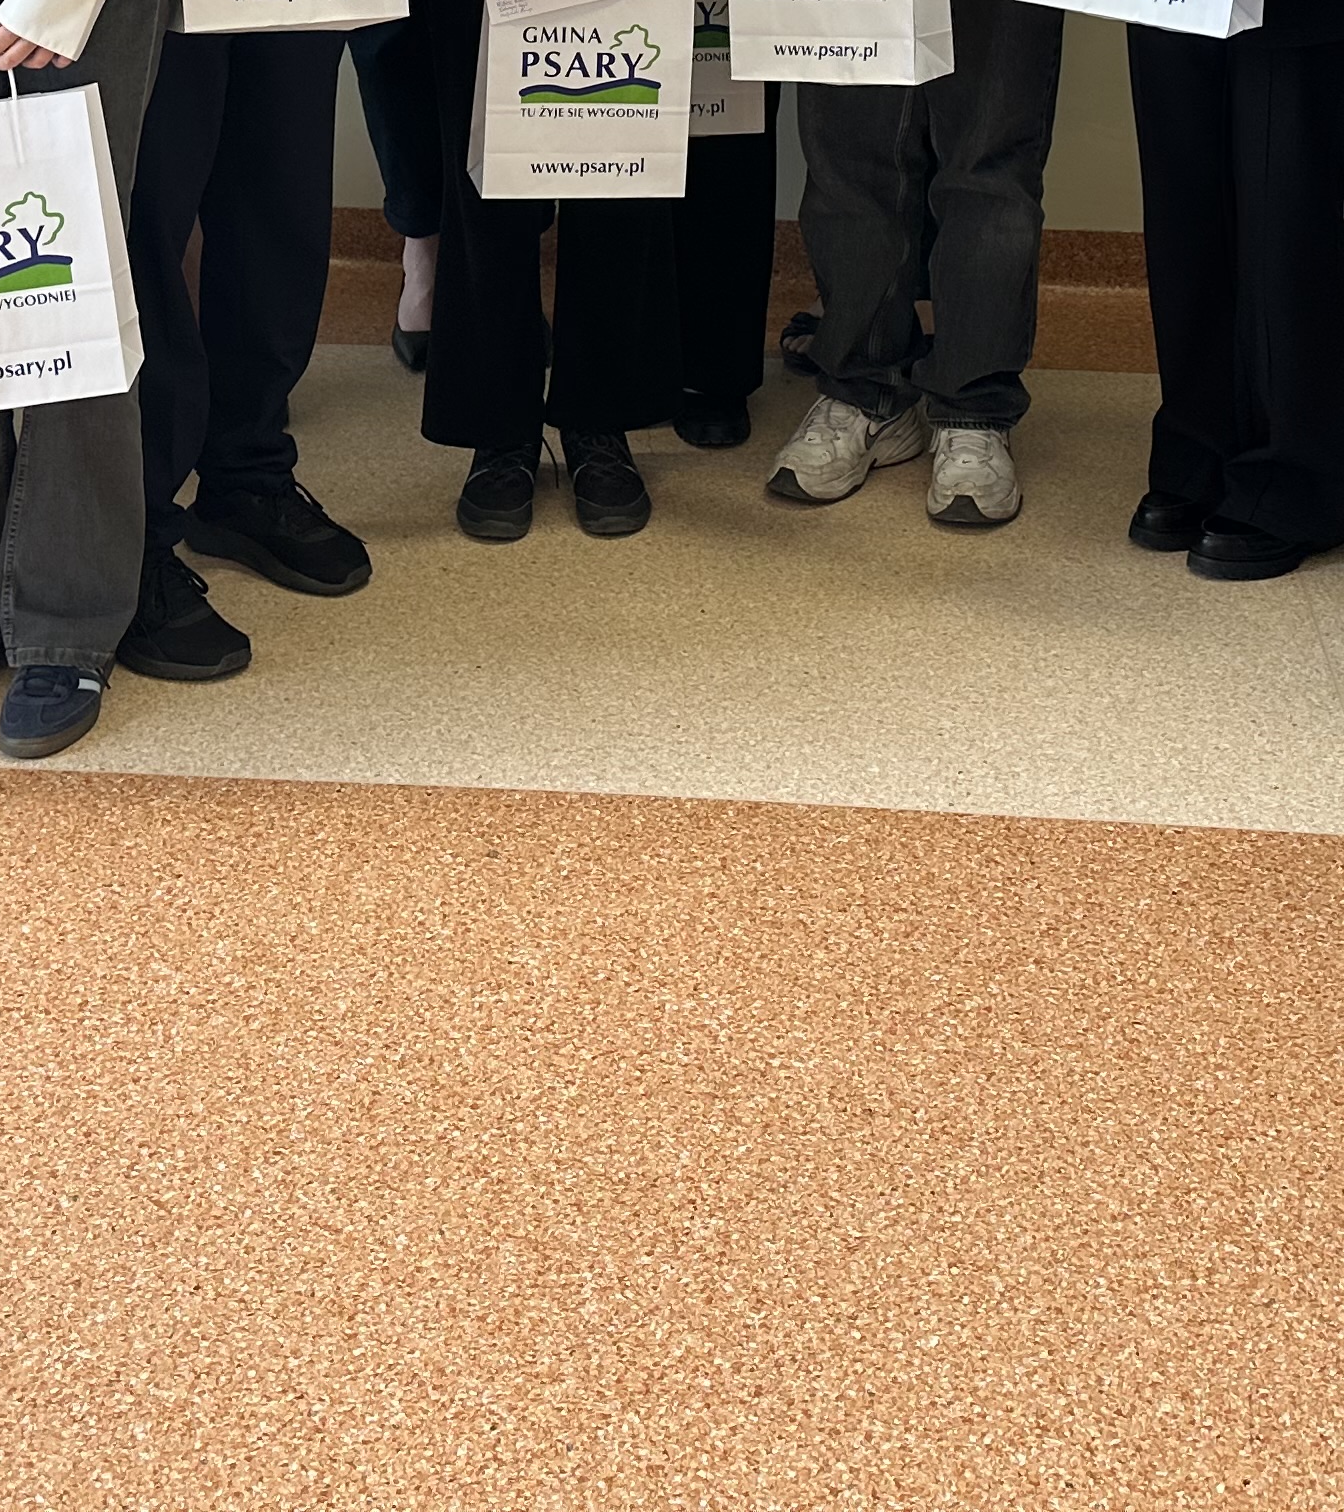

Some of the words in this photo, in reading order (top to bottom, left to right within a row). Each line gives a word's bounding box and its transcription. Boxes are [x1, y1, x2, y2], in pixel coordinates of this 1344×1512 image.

[522, 26, 602, 44] GMINA
[774, 42, 878, 61] www.psary.pl
[521, 51, 644, 79] PSARY
[520, 107, 536, 118] TU
[538, 105, 565, 119] ŻYJE
[567, 108, 584, 119] SIĘ
[587, 107, 659, 120] WYGODNIEJ
[531, 157, 645, 177] www.psary.pl
